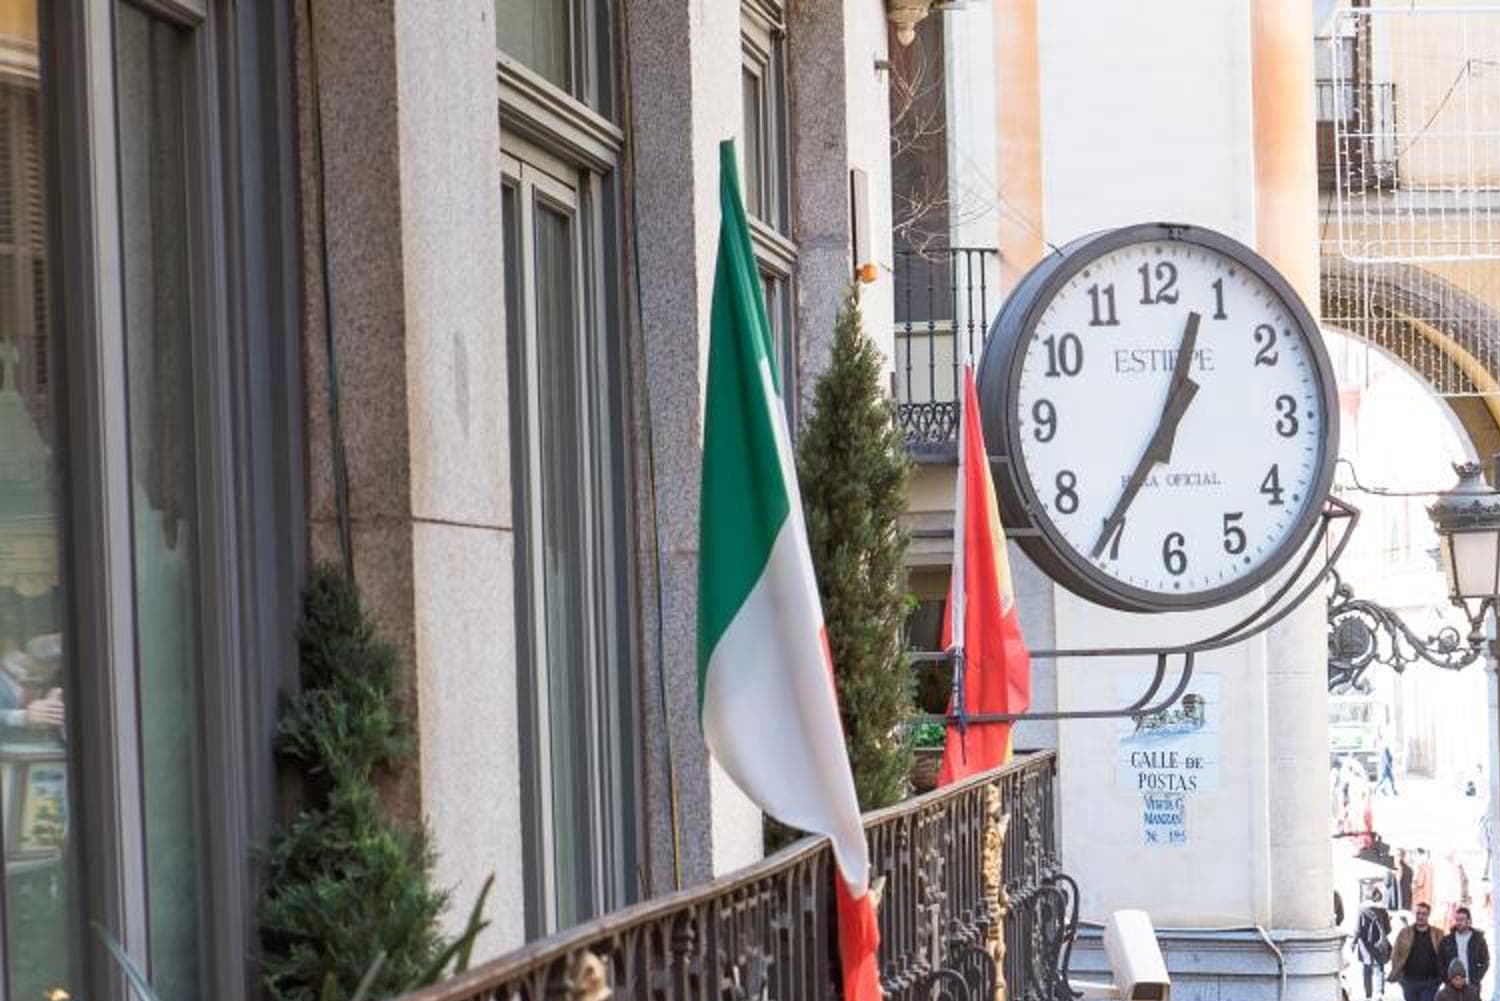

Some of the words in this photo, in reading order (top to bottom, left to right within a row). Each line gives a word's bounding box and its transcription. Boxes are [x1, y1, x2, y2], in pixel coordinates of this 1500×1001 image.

[1088, 283, 1120, 327] 11
[1138, 261, 1178, 305] 12
[1212, 278, 1228, 320] 1
[1043, 333, 1083, 377] 10
[1253, 324, 1279, 367] 2
[1031, 399, 1058, 443] 9
[1275, 394, 1299, 438] 3
[1055, 470, 1079, 514] 8
[1165, 472, 1221, 487] OFICIAL
[1260, 464, 1285, 505] 4
[1103, 514, 1126, 561] 7
[1163, 532, 1187, 576] 6
[1223, 511, 1247, 555] 5
[1131, 751, 1179, 769] CALLE
[1185, 757, 1204, 769] DE
[1138, 772, 1198, 791] POSTAS
